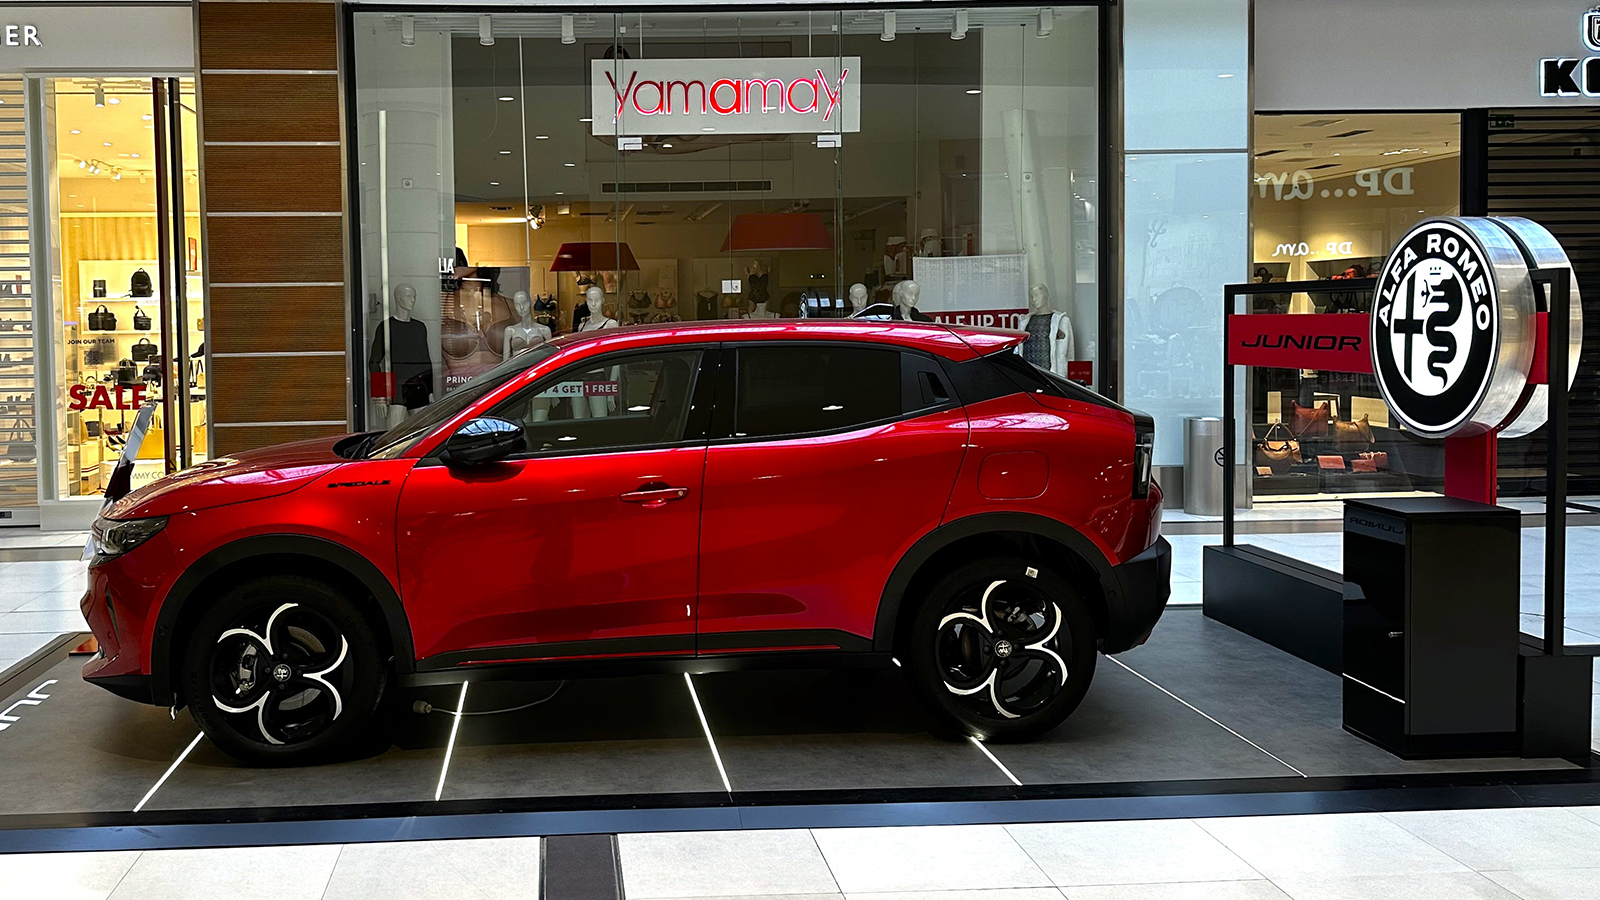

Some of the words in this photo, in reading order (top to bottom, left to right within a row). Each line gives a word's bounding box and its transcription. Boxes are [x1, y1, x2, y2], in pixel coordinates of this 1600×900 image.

[0, 25, 43, 47] ER
[604, 68, 849, 123] yamamay
[1379, 246, 1418, 328] ALFA
[1426, 233, 1490, 331] ROMEO
[1241, 334, 1362, 352] JUNIOR
[69, 384, 147, 410] SALE
[562, 385, 582, 393] GET
[592, 384, 618, 393] FREE
